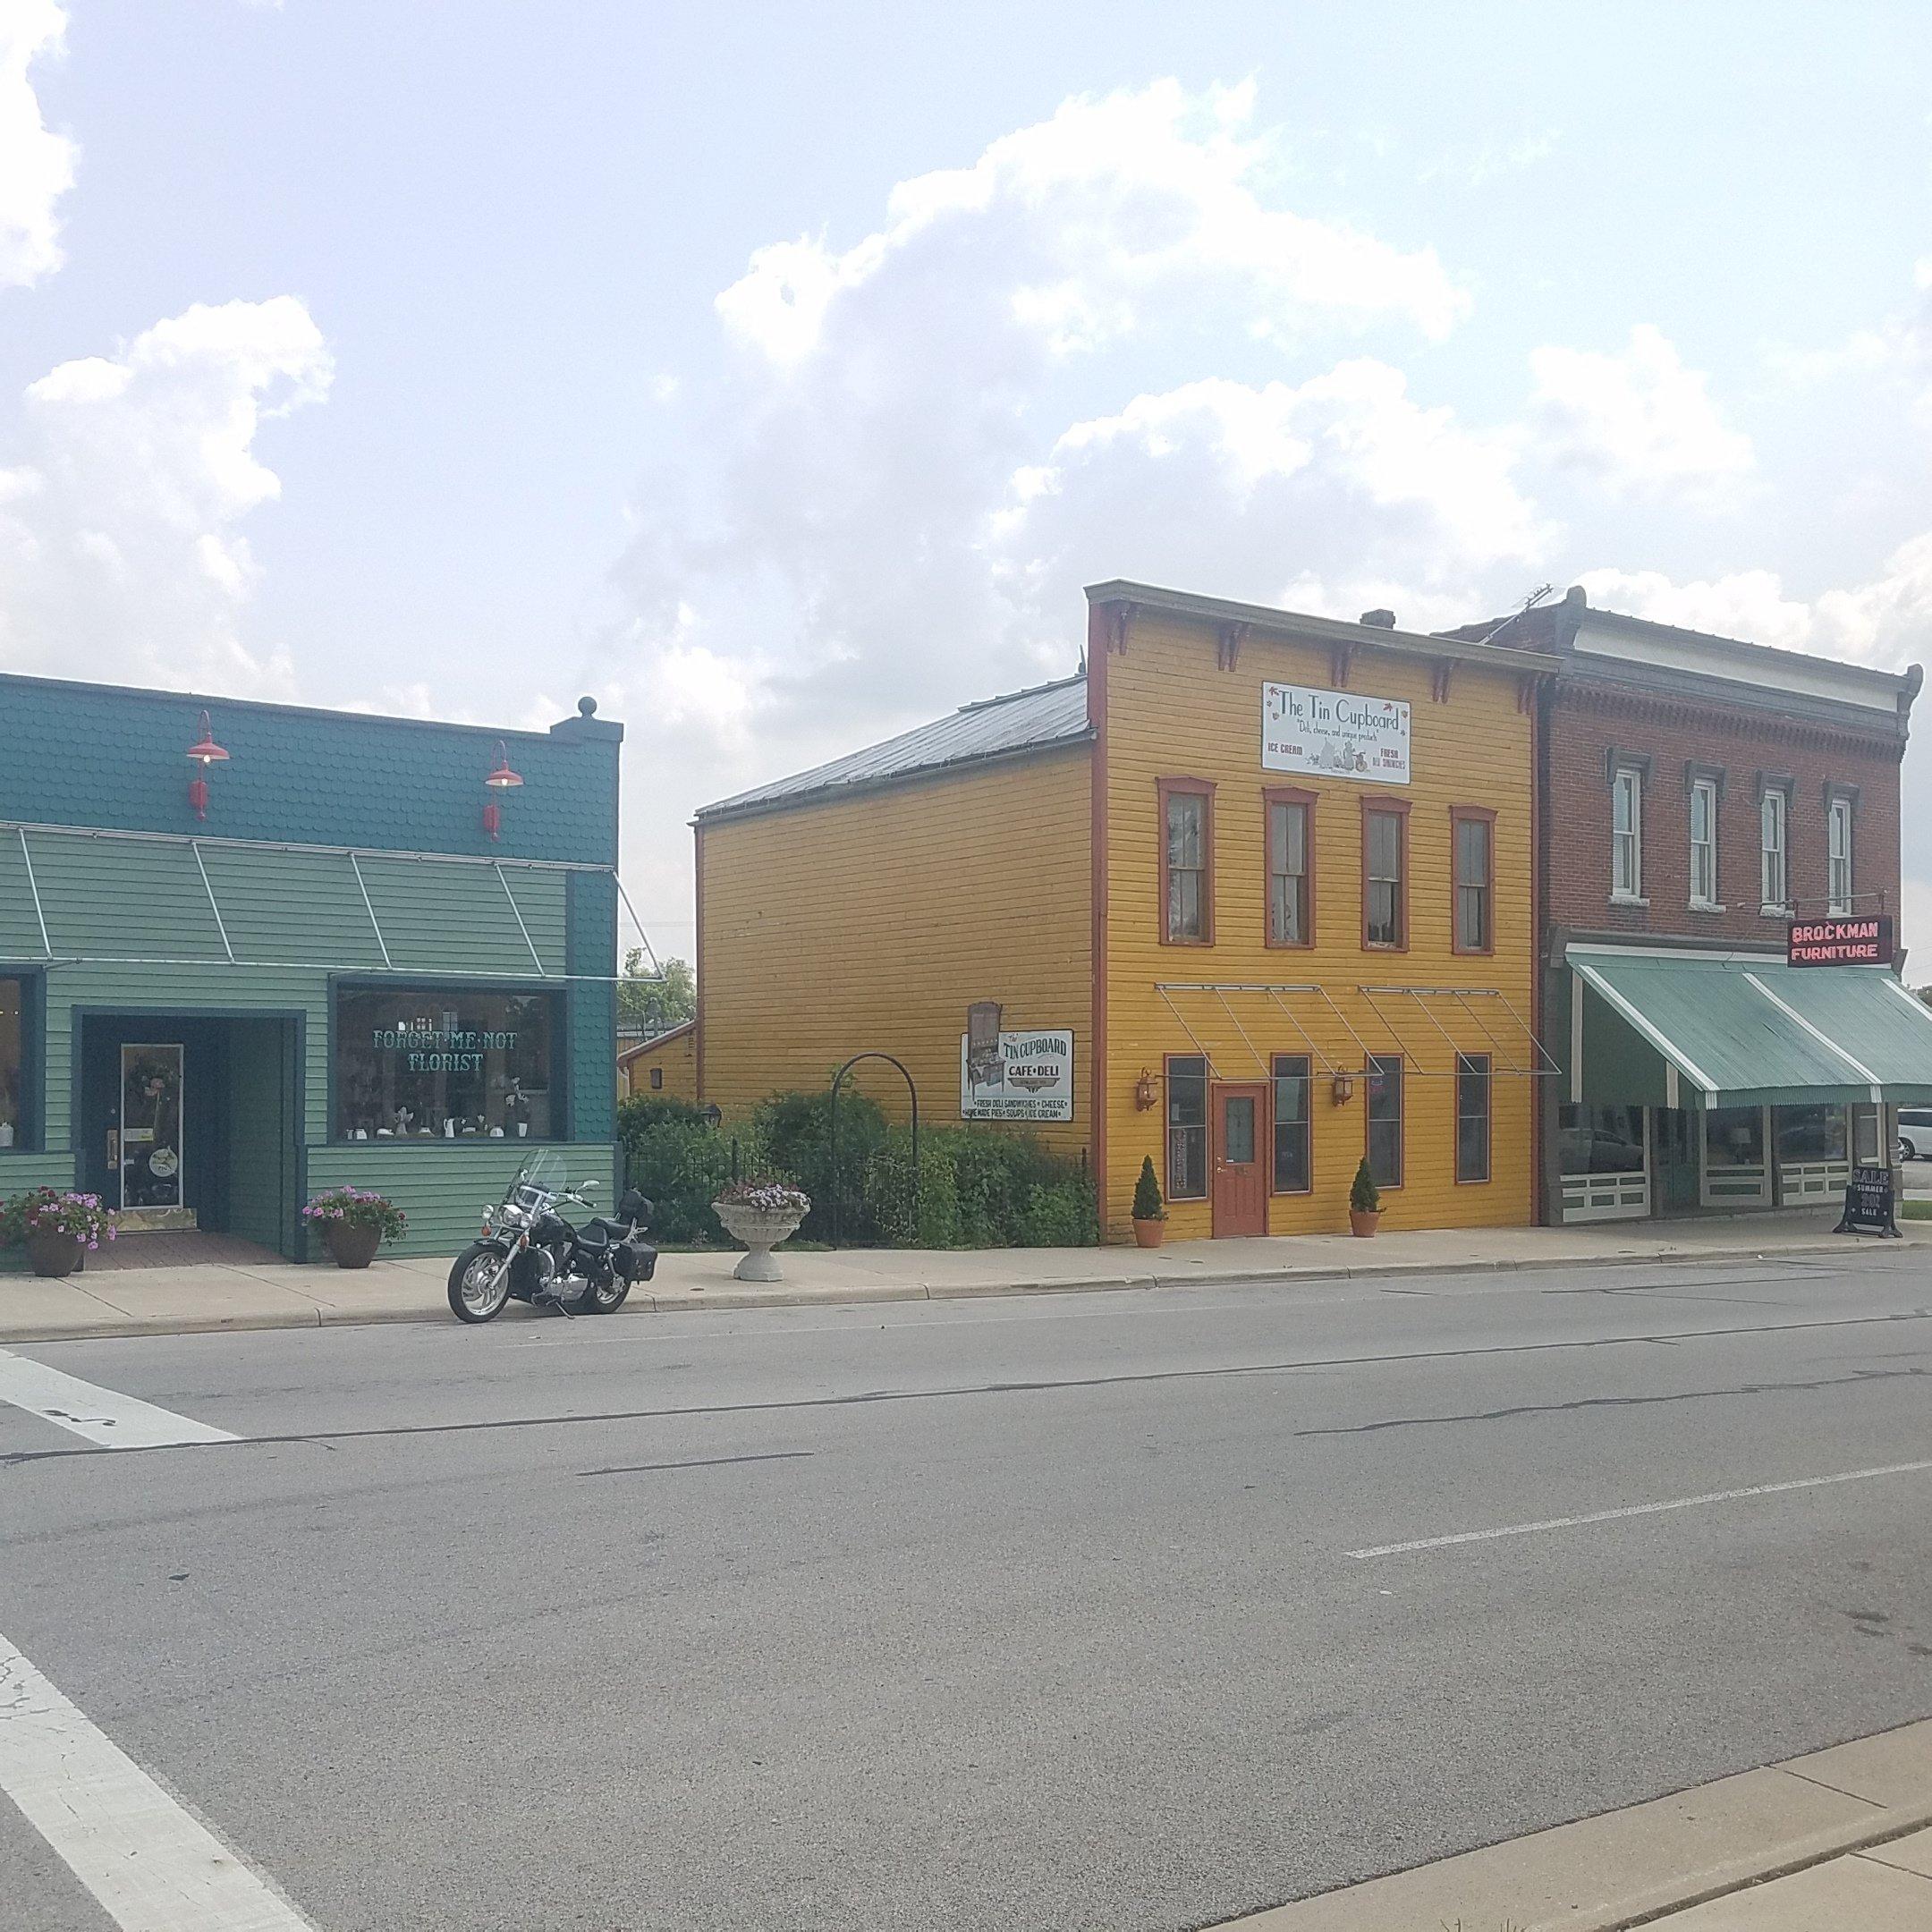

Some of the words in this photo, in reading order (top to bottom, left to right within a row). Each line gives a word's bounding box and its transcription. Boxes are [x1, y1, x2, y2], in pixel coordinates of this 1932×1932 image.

[1278, 690, 1303, 716] The
[1308, 694, 1330, 720] Tin
[1335, 699, 1399, 730] Cupboard
[1332, 724, 1341, 737] and
[1267, 742, 1279, 753] ICE
[1280, 743, 1303, 756] CREAM
[1792, 921, 1878, 943] BROCKMAN
[1791, 944, 1878, 961] FURNITURE
[1004, 1042, 1020, 1059] TIN
[1020, 1038, 1066, 1058] CUPBOARD
[409, 1053, 484, 1072] FLORIST
[1009, 1065, 1032, 1076] CAFE
[1038, 1065, 1059, 1076] DELI
[977, 1099, 992, 1108] FRESH
[992, 1099, 1004, 1108] DELI
[1004, 1099, 1037, 1108] SANDWICHES
[1041, 1099, 1064, 1109] CHEESE
[1006, 1108, 1025, 1117] SOUPS
[1038, 1109, 1058, 1118] CREAM
[1852, 1168, 1889, 1185] SALE
[1857, 1184, 1884, 1193] SUMMER
[1861, 1208, 1877, 1216] SALE
